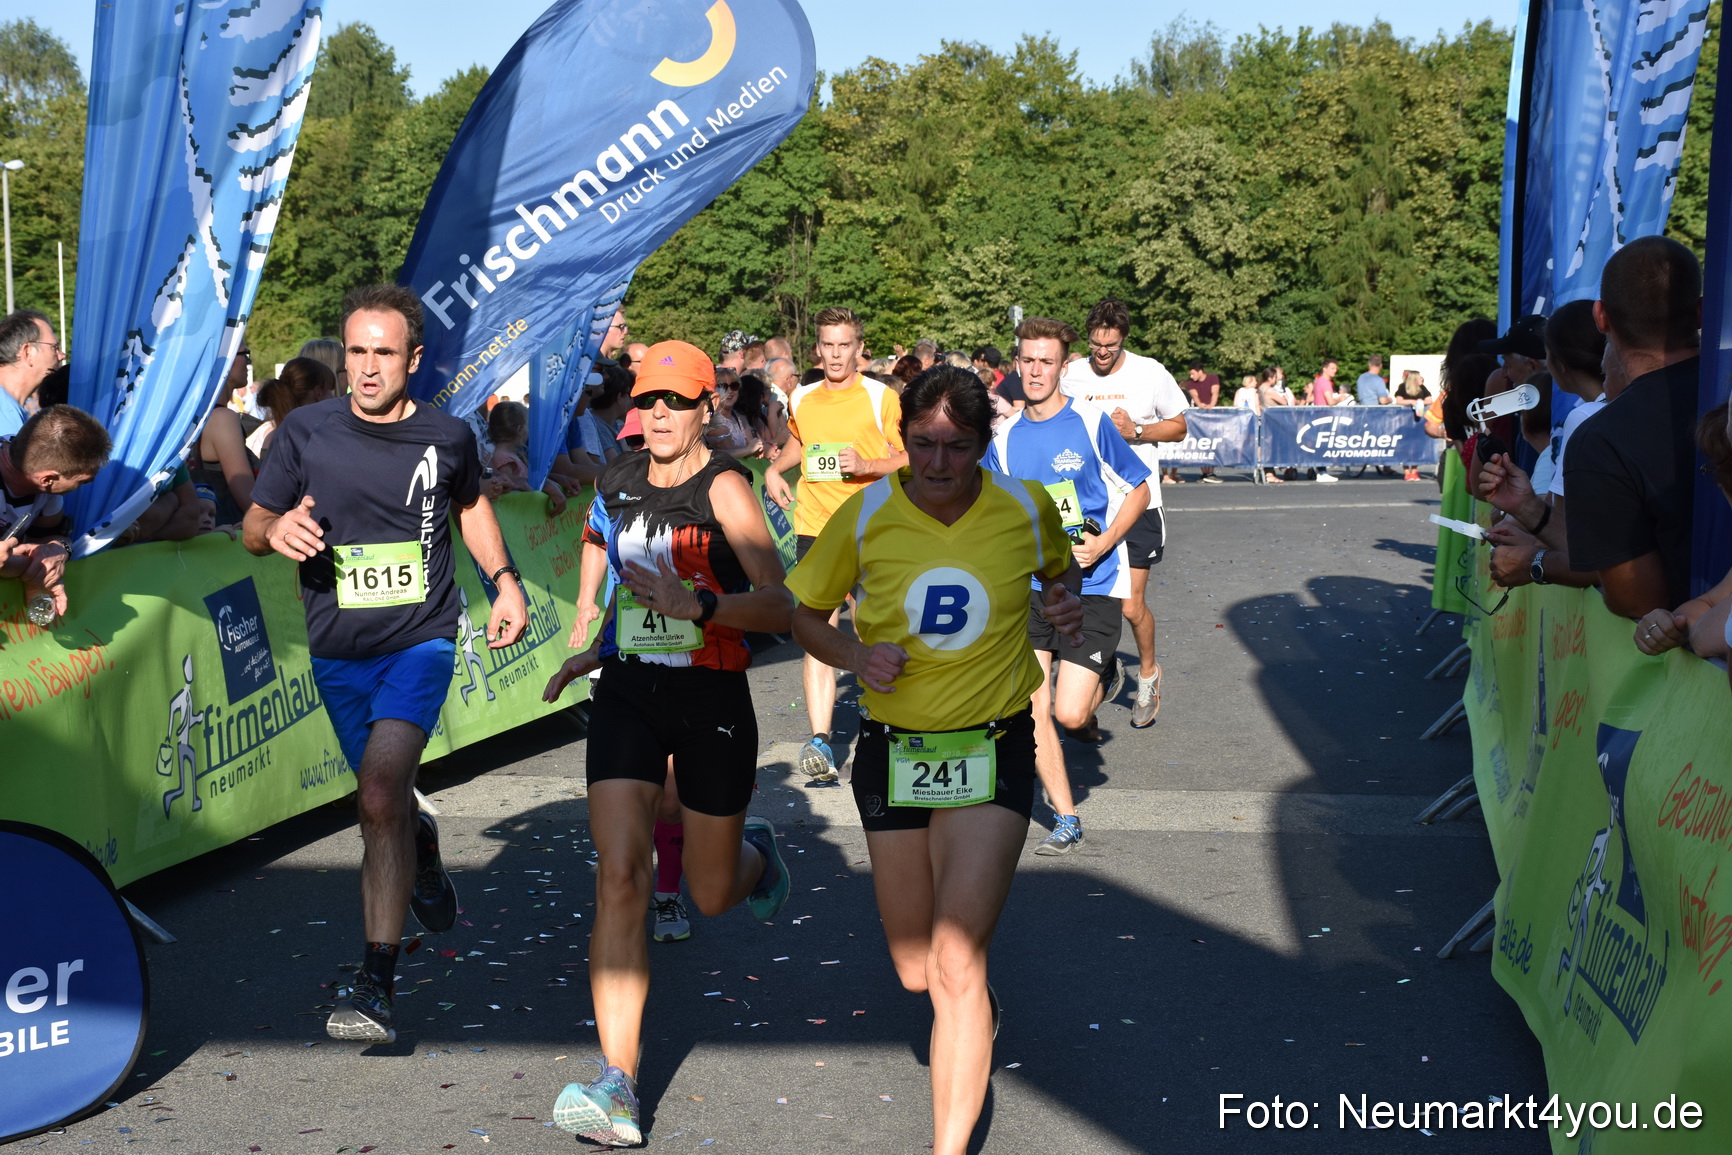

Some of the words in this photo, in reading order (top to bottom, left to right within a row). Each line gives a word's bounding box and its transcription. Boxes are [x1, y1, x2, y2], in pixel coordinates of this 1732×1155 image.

[599, 163, 666, 225] Druck
[664, 128, 710, 171] und
[705, 66, 788, 135] Medien
[421, 99, 690, 330] Frischmann
[1315, 430, 1403, 448] Fischer
[1322, 449, 1395, 458] AUTOMOBILE
[348, 564, 412, 590] 1615
[380, 588, 407, 596] Andreas
[642, 608, 667, 633] 41
[919, 585, 970, 635] B
[226, 615, 258, 644] Fischer
[499, 654, 539, 691] neumarkt
[203, 664, 323, 769] firmenlau
[210, 745, 272, 799] neumarkt
[912, 759, 968, 788] 241
[912, 788, 954, 796] Miesbauer
